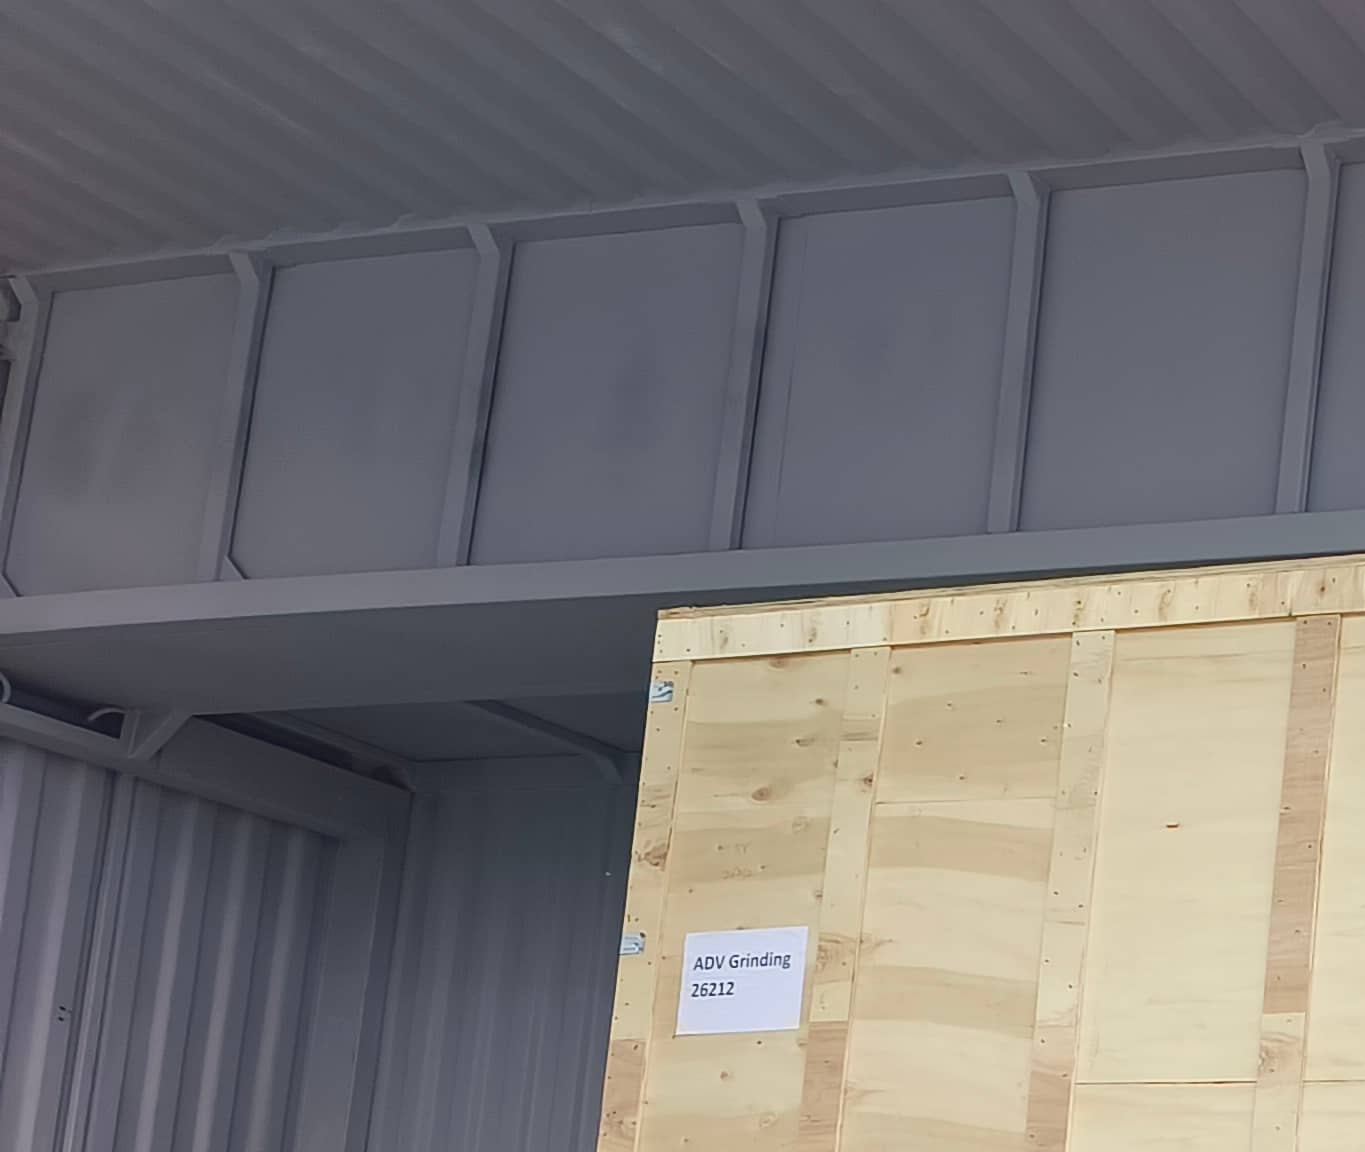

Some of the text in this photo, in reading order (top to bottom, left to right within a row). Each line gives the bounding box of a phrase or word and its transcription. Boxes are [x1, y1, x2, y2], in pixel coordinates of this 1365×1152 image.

[693, 951, 792, 971] ADV Grinding
[691, 981, 735, 998] 26212
